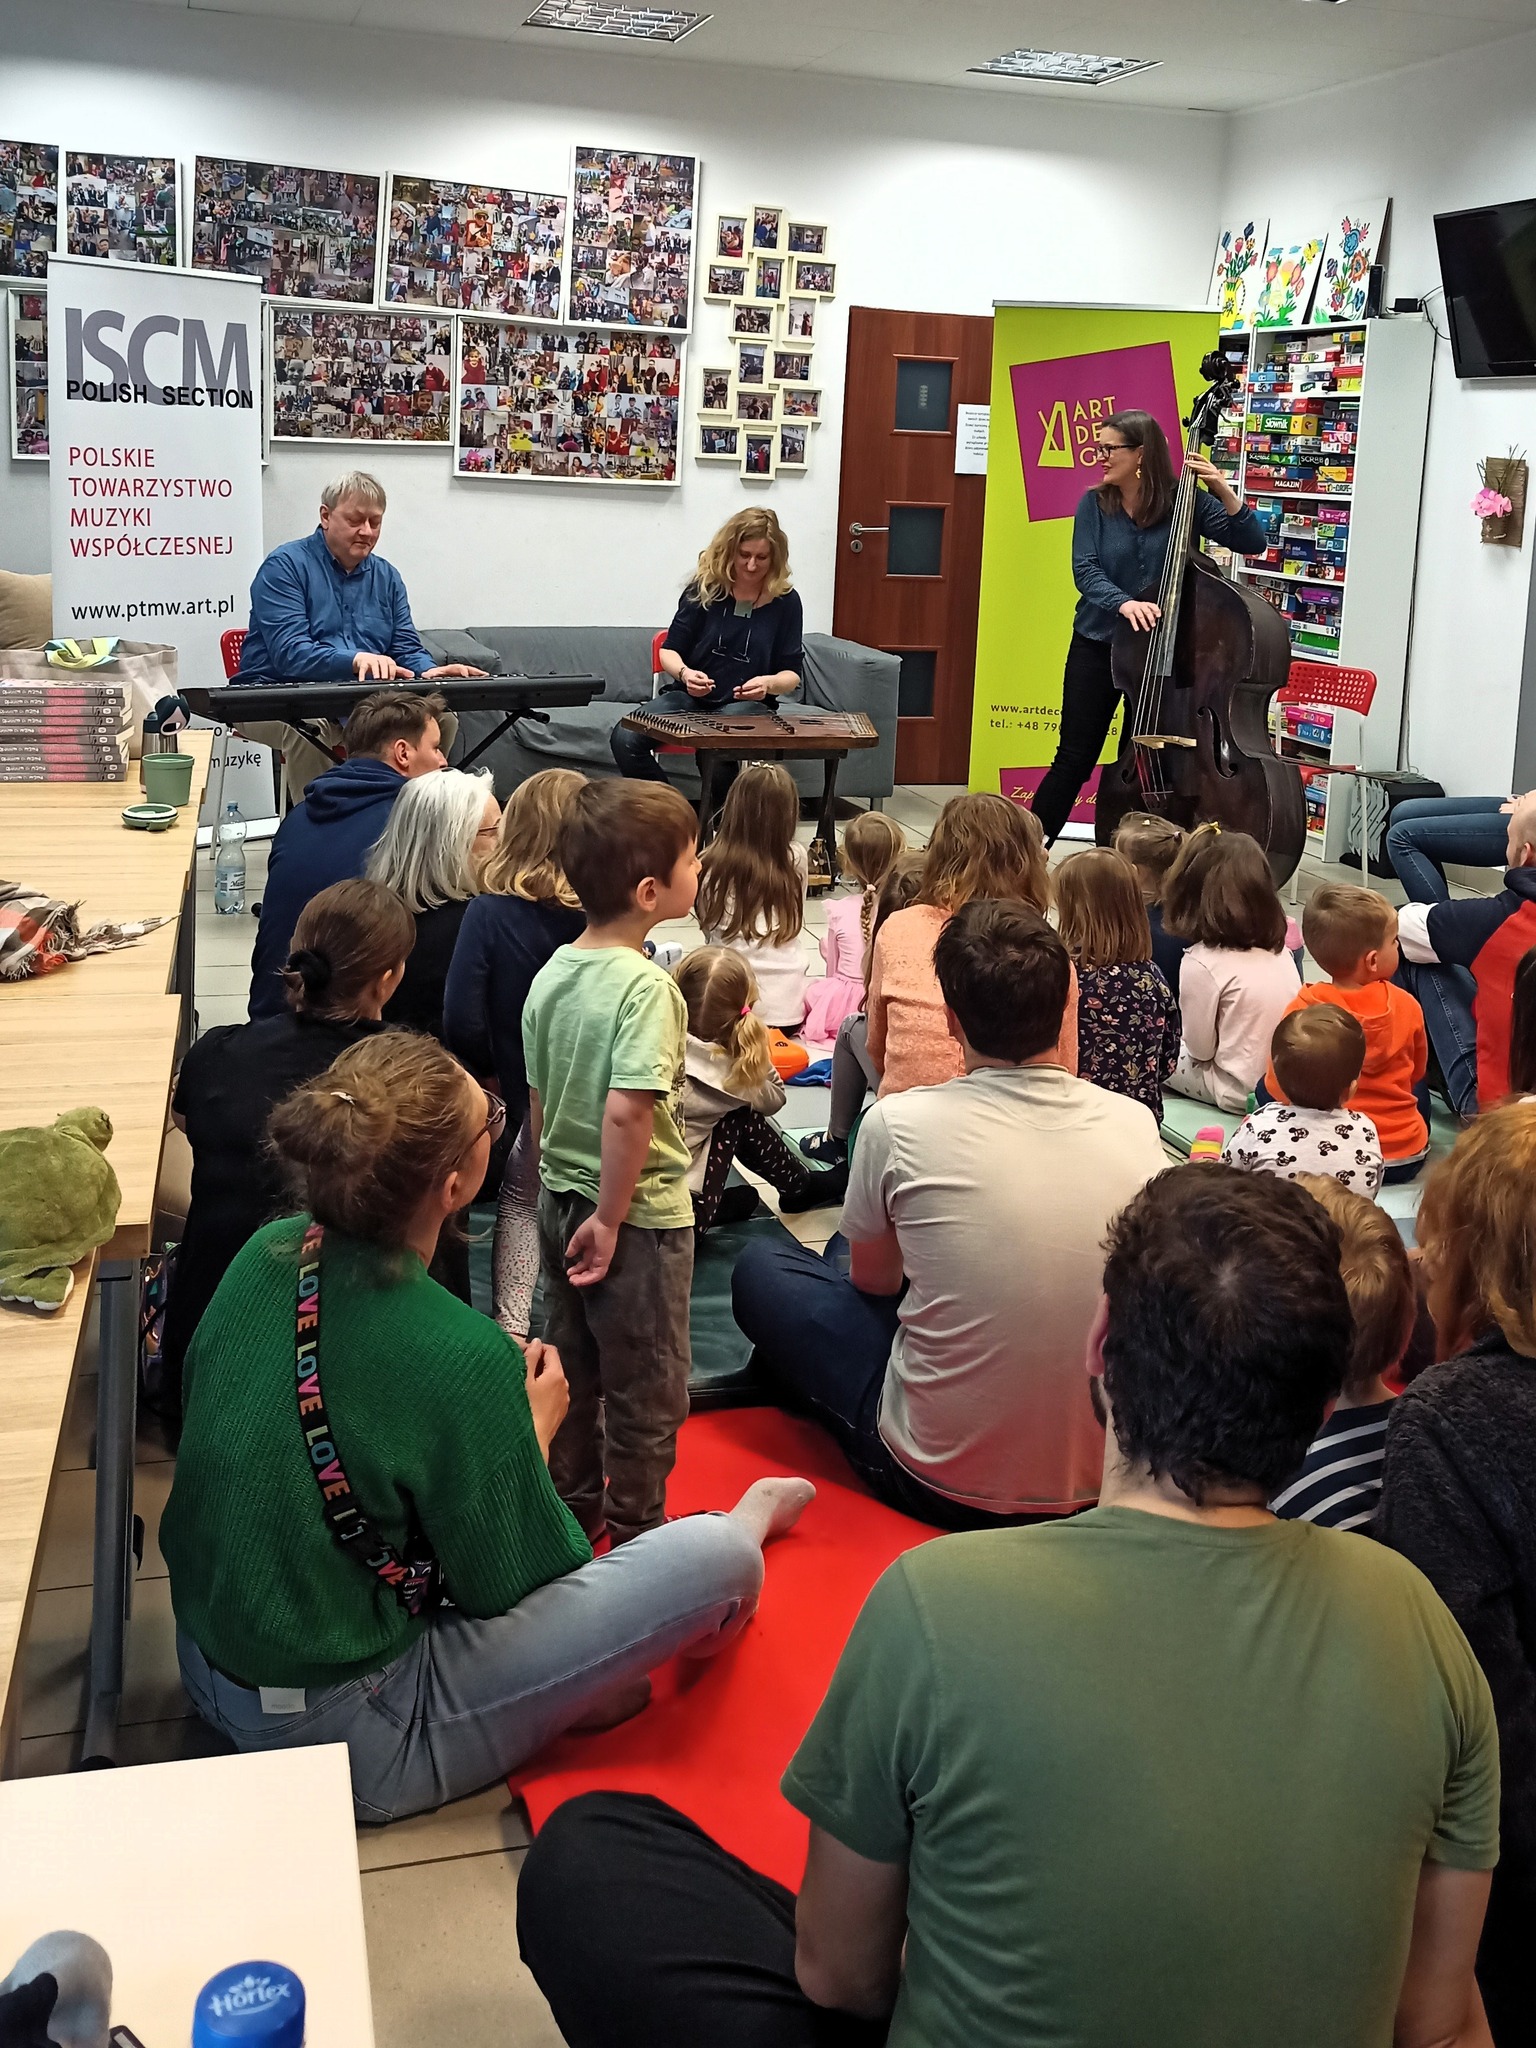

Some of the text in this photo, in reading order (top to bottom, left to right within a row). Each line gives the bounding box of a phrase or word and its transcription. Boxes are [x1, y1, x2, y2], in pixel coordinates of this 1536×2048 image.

[65, 307, 251, 406] ISCM
[66, 379, 253, 409] POLISH SECTION
[1073, 396, 1116, 422] ART
[1075, 422, 1103, 445] DE
[69, 446, 155, 468] POLSKIE
[68, 477, 233, 497] TOWARZYSTWO
[1274, 480, 1300, 488] MAGAZIN
[70, 507, 152, 527] MUZYKI
[69, 533, 234, 558] WSPÓŁCZESNEJ
[71, 595, 234, 622] www.ptmw.art.pl
[990, 719, 1014, 729] tel.:
[1016, 721, 1039, 731] +48
[211, 750, 262, 769] muzykę
[297, 1262, 319, 1333] LOVE
[297, 1340, 323, 1416] LOVE
[306, 1425, 351, 1501] LOVE
[208, 1979, 291, 2017] Hortex
